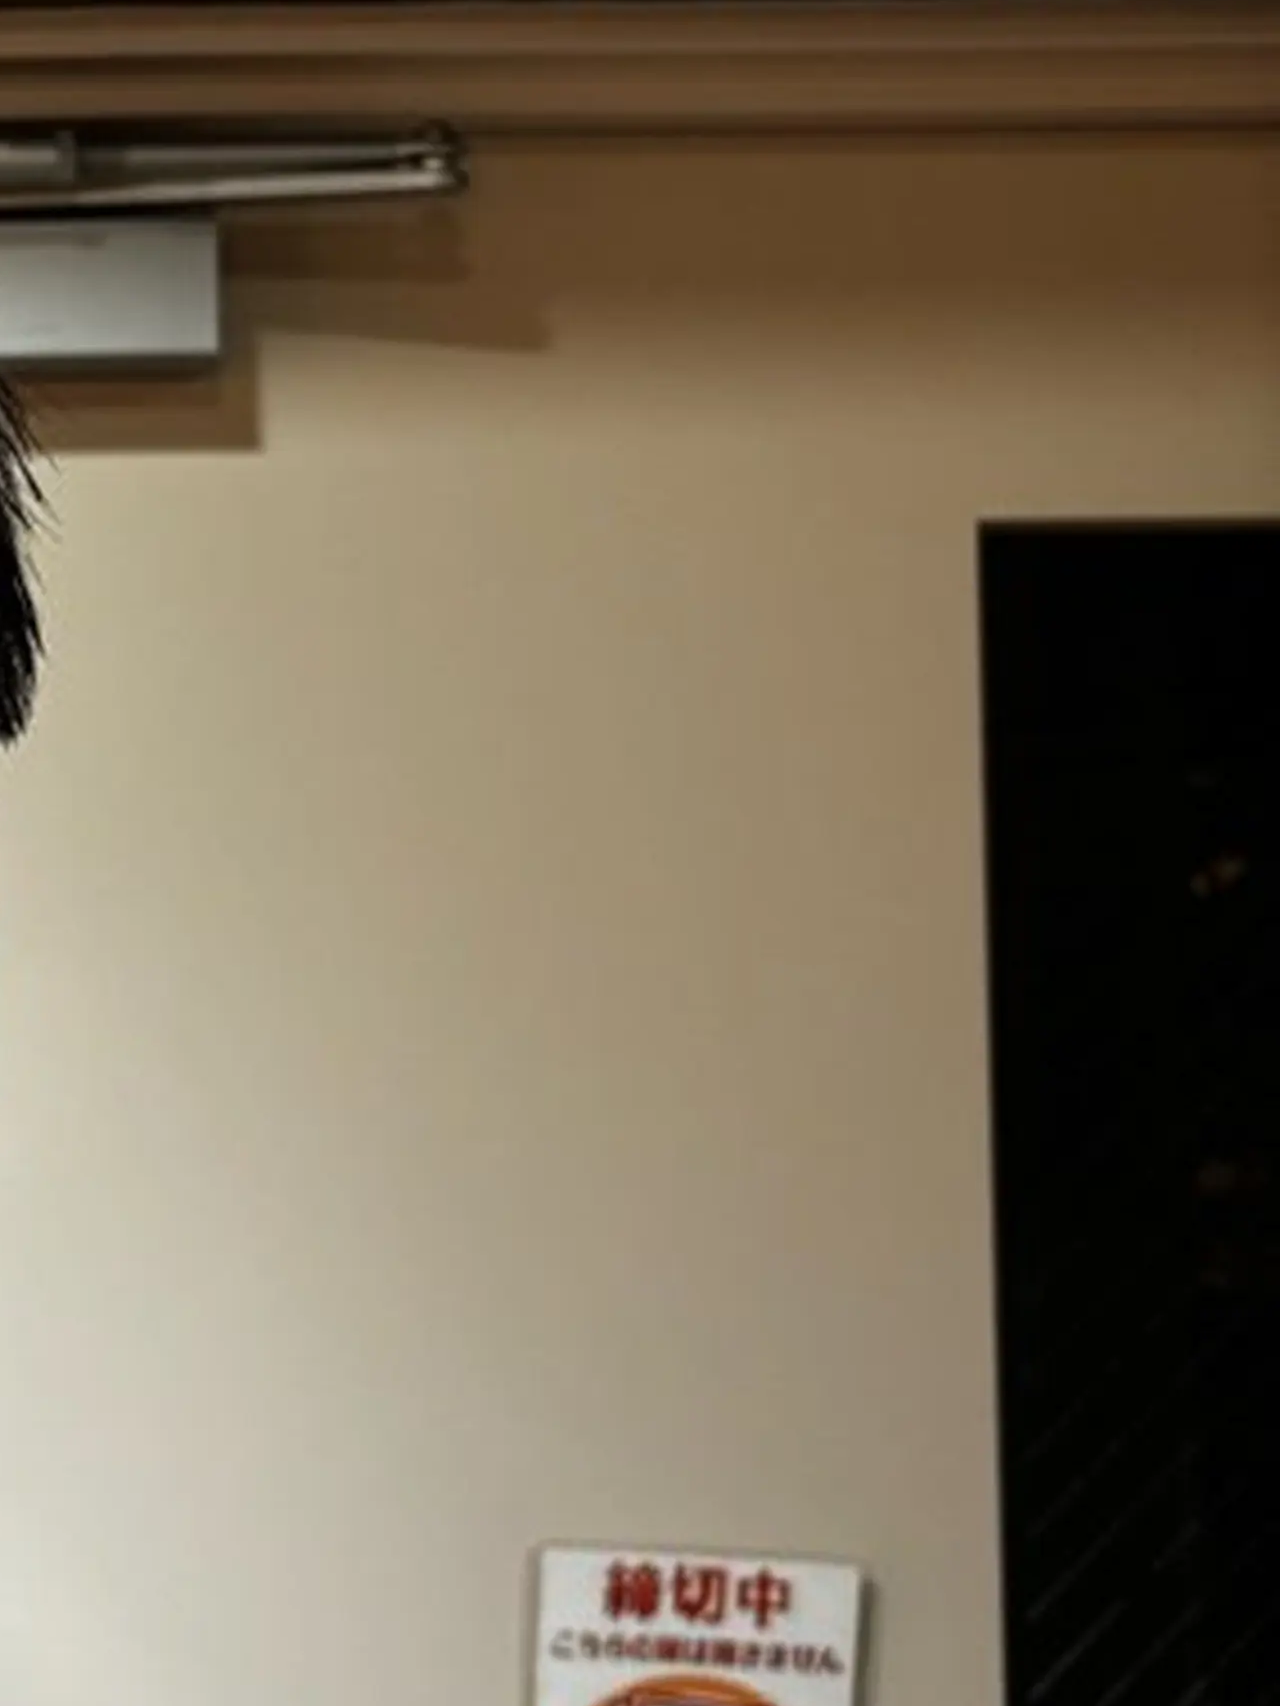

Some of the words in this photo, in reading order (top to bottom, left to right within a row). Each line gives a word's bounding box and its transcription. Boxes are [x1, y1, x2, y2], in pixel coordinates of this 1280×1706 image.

[548, 1626, 845, 1674] こちらのはきません
